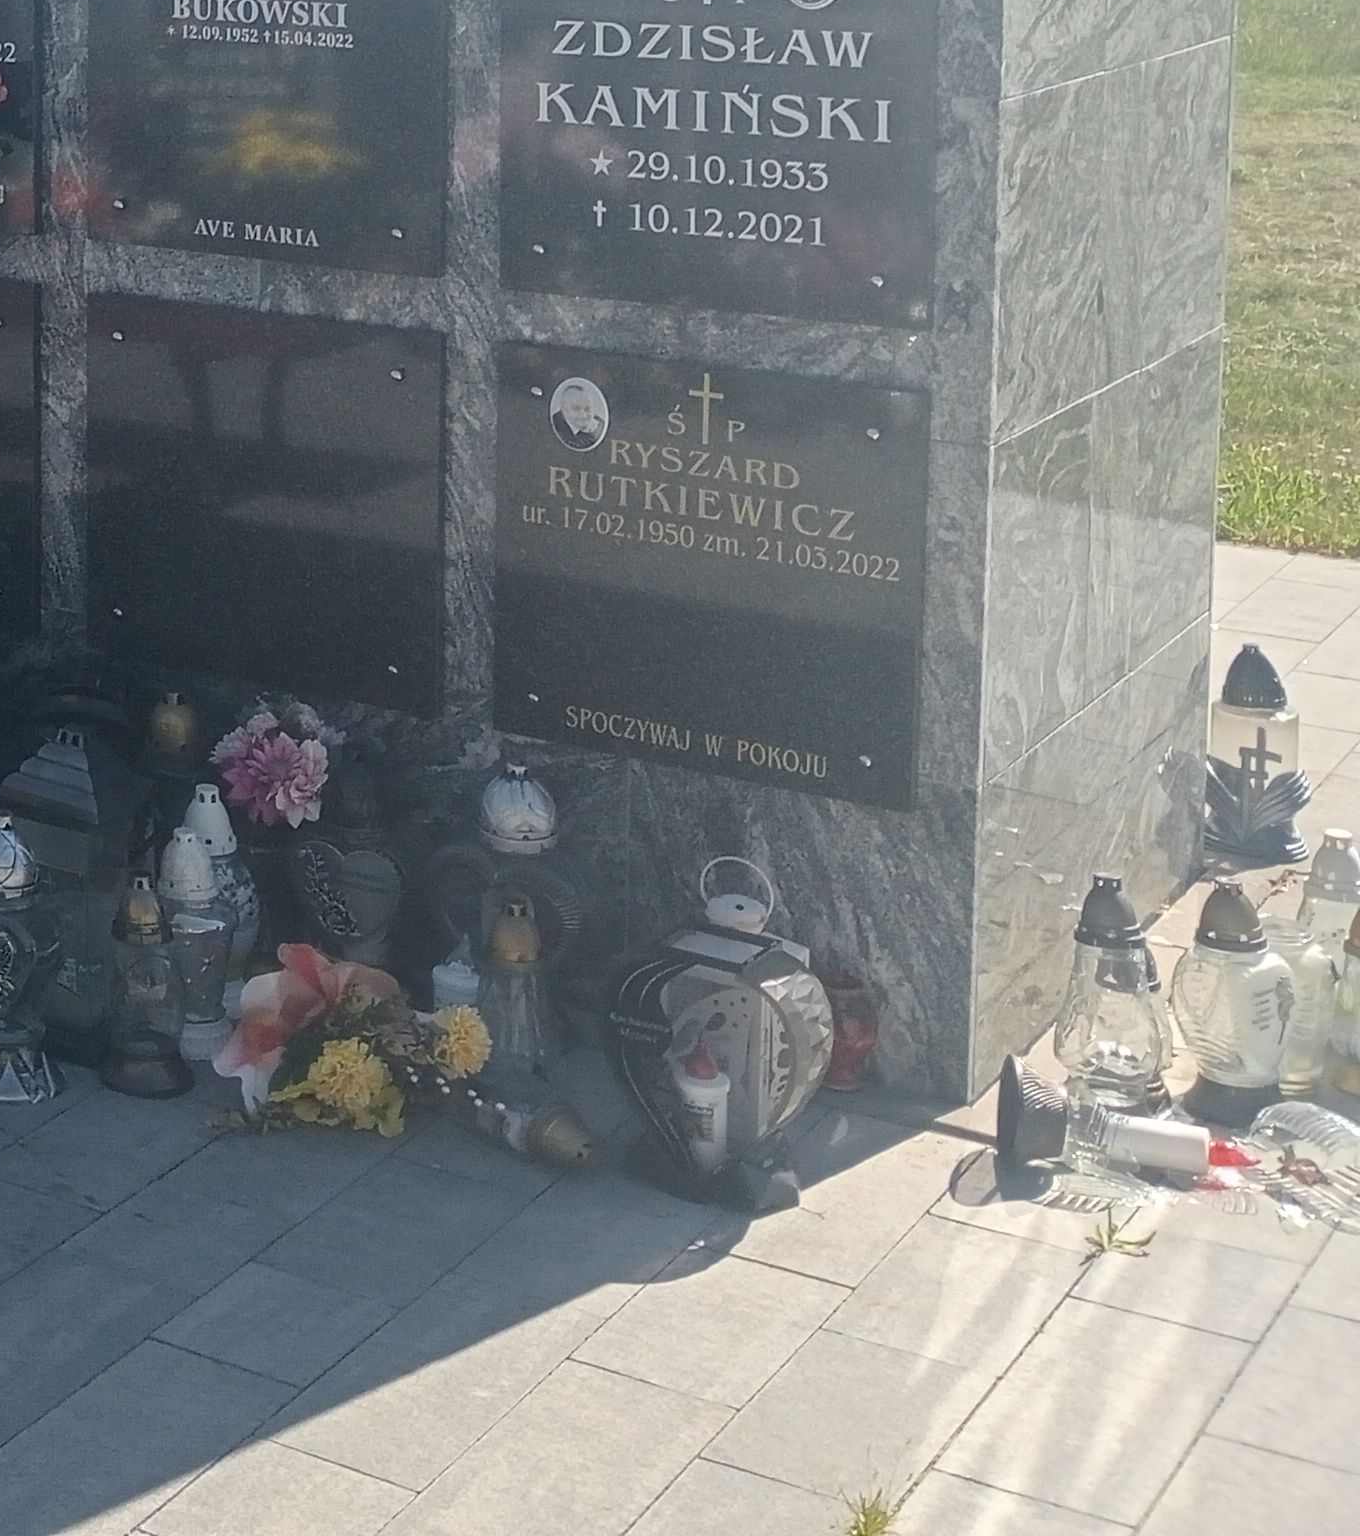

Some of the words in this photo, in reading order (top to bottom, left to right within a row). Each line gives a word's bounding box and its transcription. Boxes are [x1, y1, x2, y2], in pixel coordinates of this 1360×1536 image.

[182, 25, 259, 44] 12.09.1952
[552, 20, 873, 68] ZDZISŁAW
[536, 82, 892, 143] KAMIŃSKI
[627, 150, 829, 192] 29.10.1933
[194, 219, 235, 238] AVE
[244, 224, 320, 247] MARIA
[629, 203, 826, 247] 10.12.2021
[667, 404, 686, 436] Ś
[727, 420, 746, 442] P
[610, 439, 800, 490] RYSZARD
[548, 466, 856, 542] RUTKIEWICZ
[523, 504, 550, 526] ur.
[562, 506, 695, 548] 17.02.1950
[702, 534, 746, 556] zm.
[566, 706, 691, 751] SPOCZYWAJ
[705, 734, 723, 757] W
[737, 740, 828, 778] POKOJU
